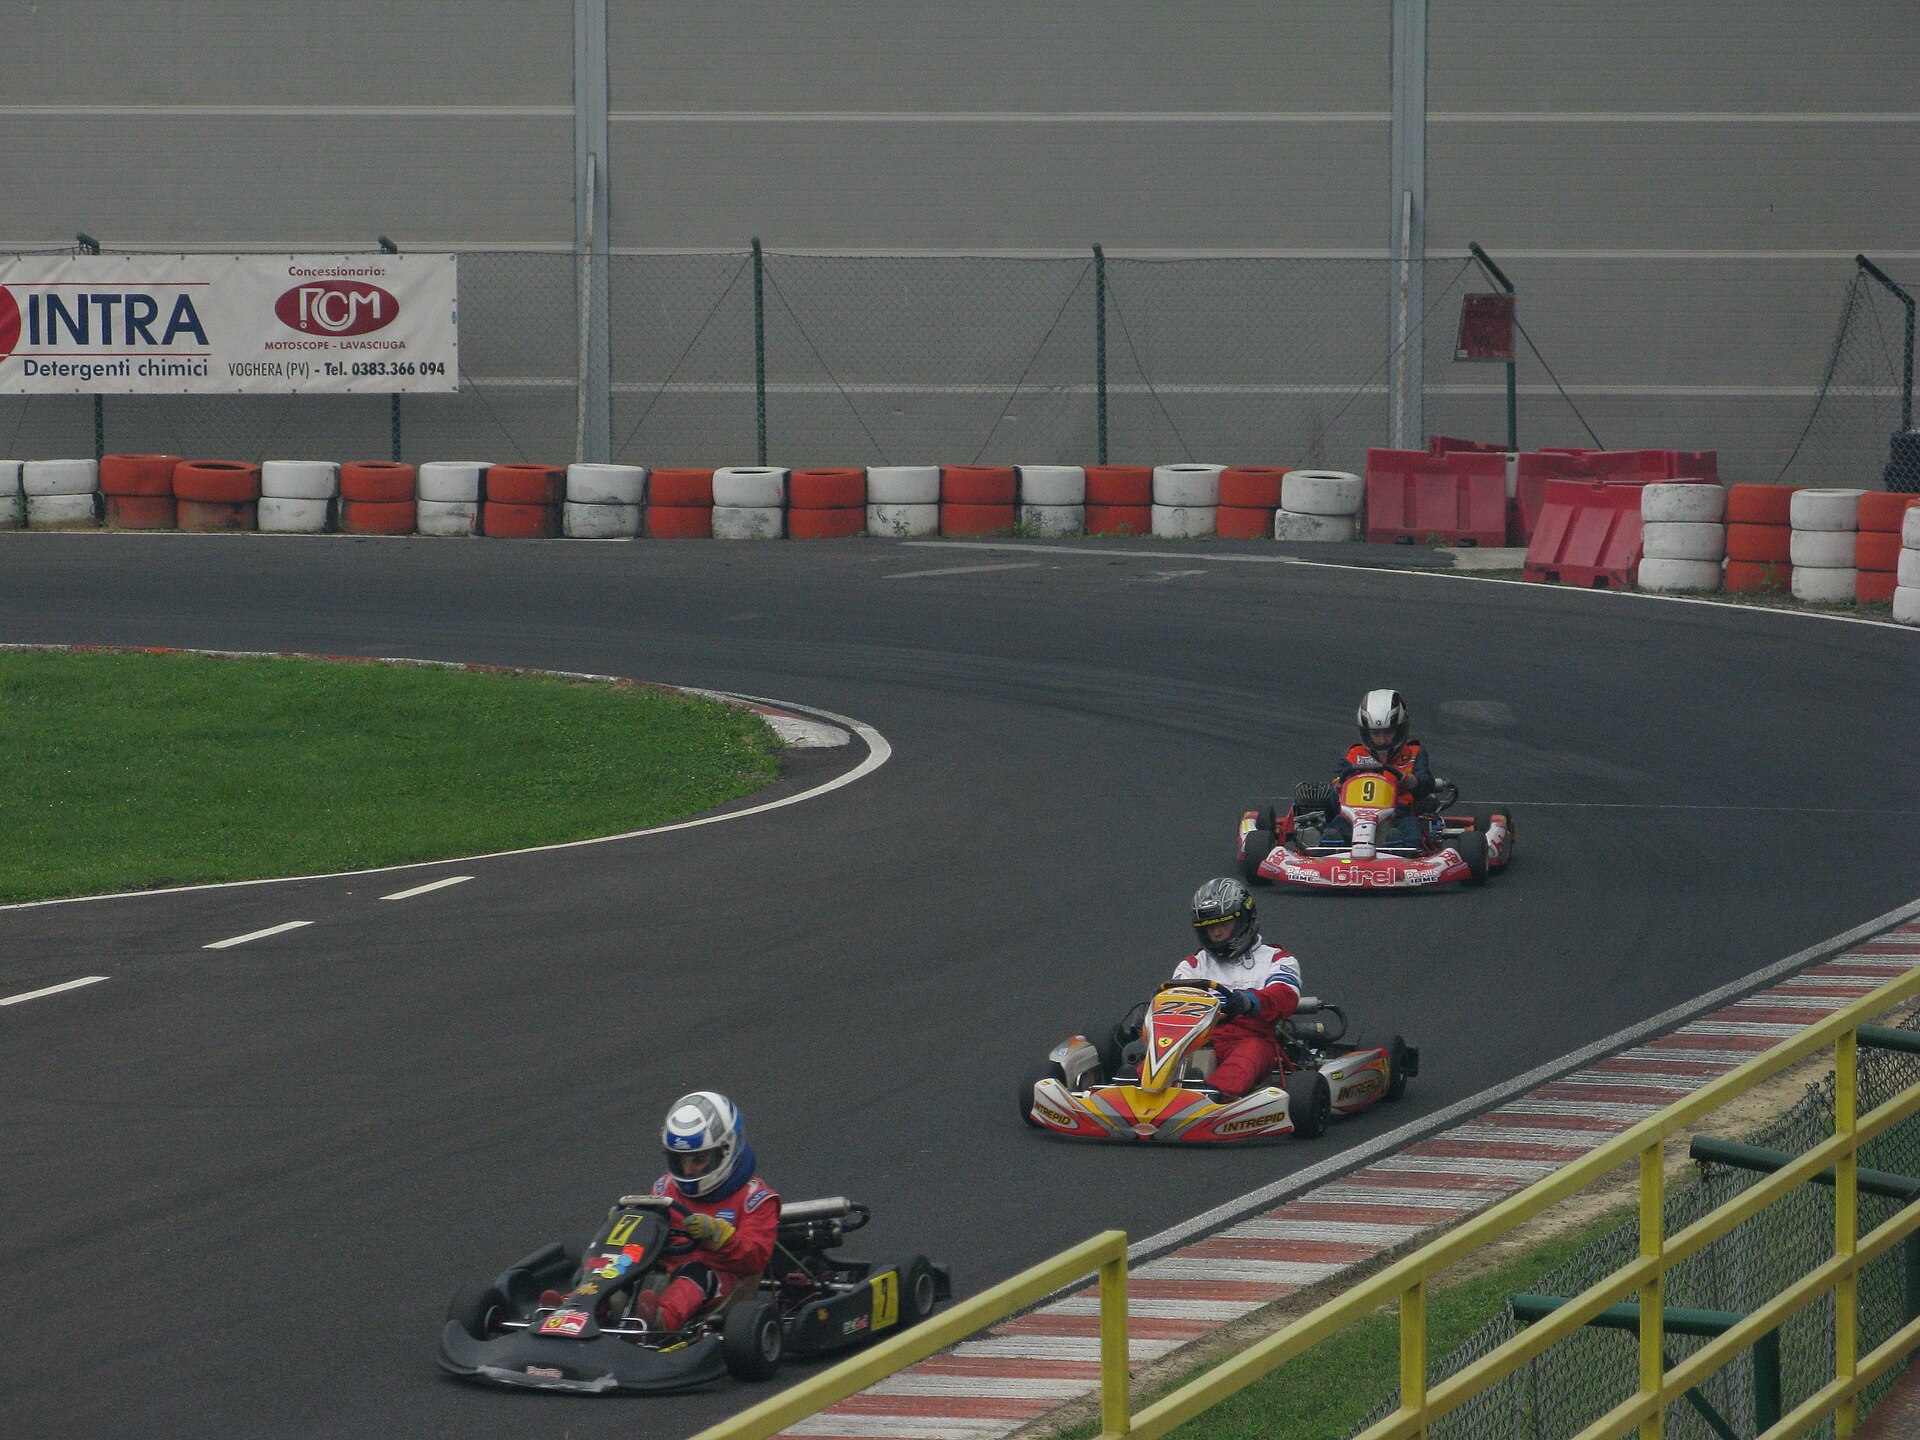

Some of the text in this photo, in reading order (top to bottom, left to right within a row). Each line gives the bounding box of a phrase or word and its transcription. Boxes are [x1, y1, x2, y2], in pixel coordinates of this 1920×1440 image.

[288, 266, 385, 277] Concessionario:
[28, 293, 210, 346] INTRA
[264, 341, 329, 350] MOTOSCOPE
[340, 341, 406, 350] LAVASCIUGA
[24, 358, 208, 381] Detergenti chimici
[228, 363, 283, 377] VOGHERA
[286, 362, 310, 380] (PV)
[324, 362, 348, 376] Tel.
[352, 362, 416, 376] 0383.366
[419, 362, 445, 376] 094
[1363, 781, 1375, 802] 9
[1286, 866, 1320, 877] Parilla
[1331, 866, 1396, 887] birel
[1405, 868, 1440, 880] Parilla
[1153, 1001, 1214, 1017] 22
[1034, 1100, 1072, 1125] INTREPID
[1223, 1111, 1286, 1132] INTREPID
[613, 1215, 636, 1241] 7
